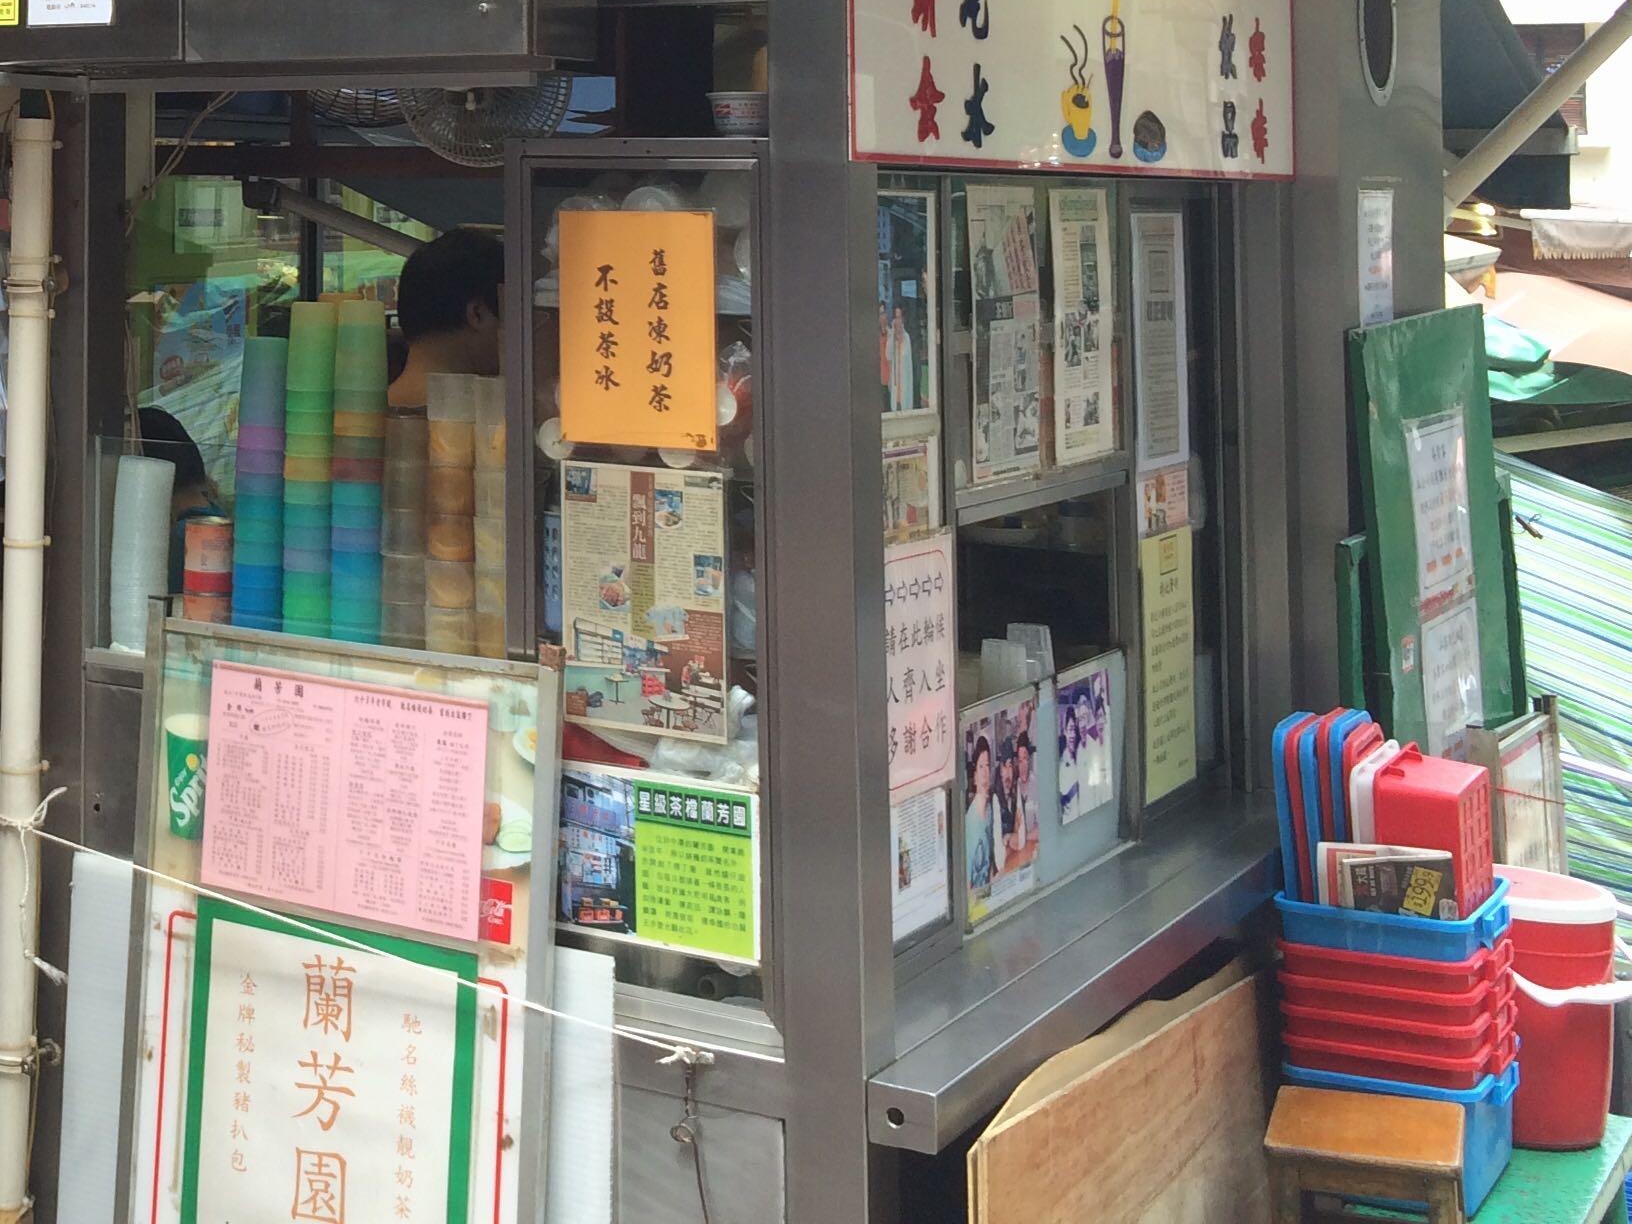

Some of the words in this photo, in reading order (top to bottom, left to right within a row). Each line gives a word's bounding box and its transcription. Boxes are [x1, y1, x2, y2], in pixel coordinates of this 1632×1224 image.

[594, 265, 620, 391] 不設茶冰
[647, 248, 673, 412] 舊店凍奶茶
[229, 972, 257, 1173] 金牌秘製豬扒包
[291, 953, 357, 1224] 蘭芳園
[394, 1012, 423, 1219] 馳名絲襪靚奶茶
